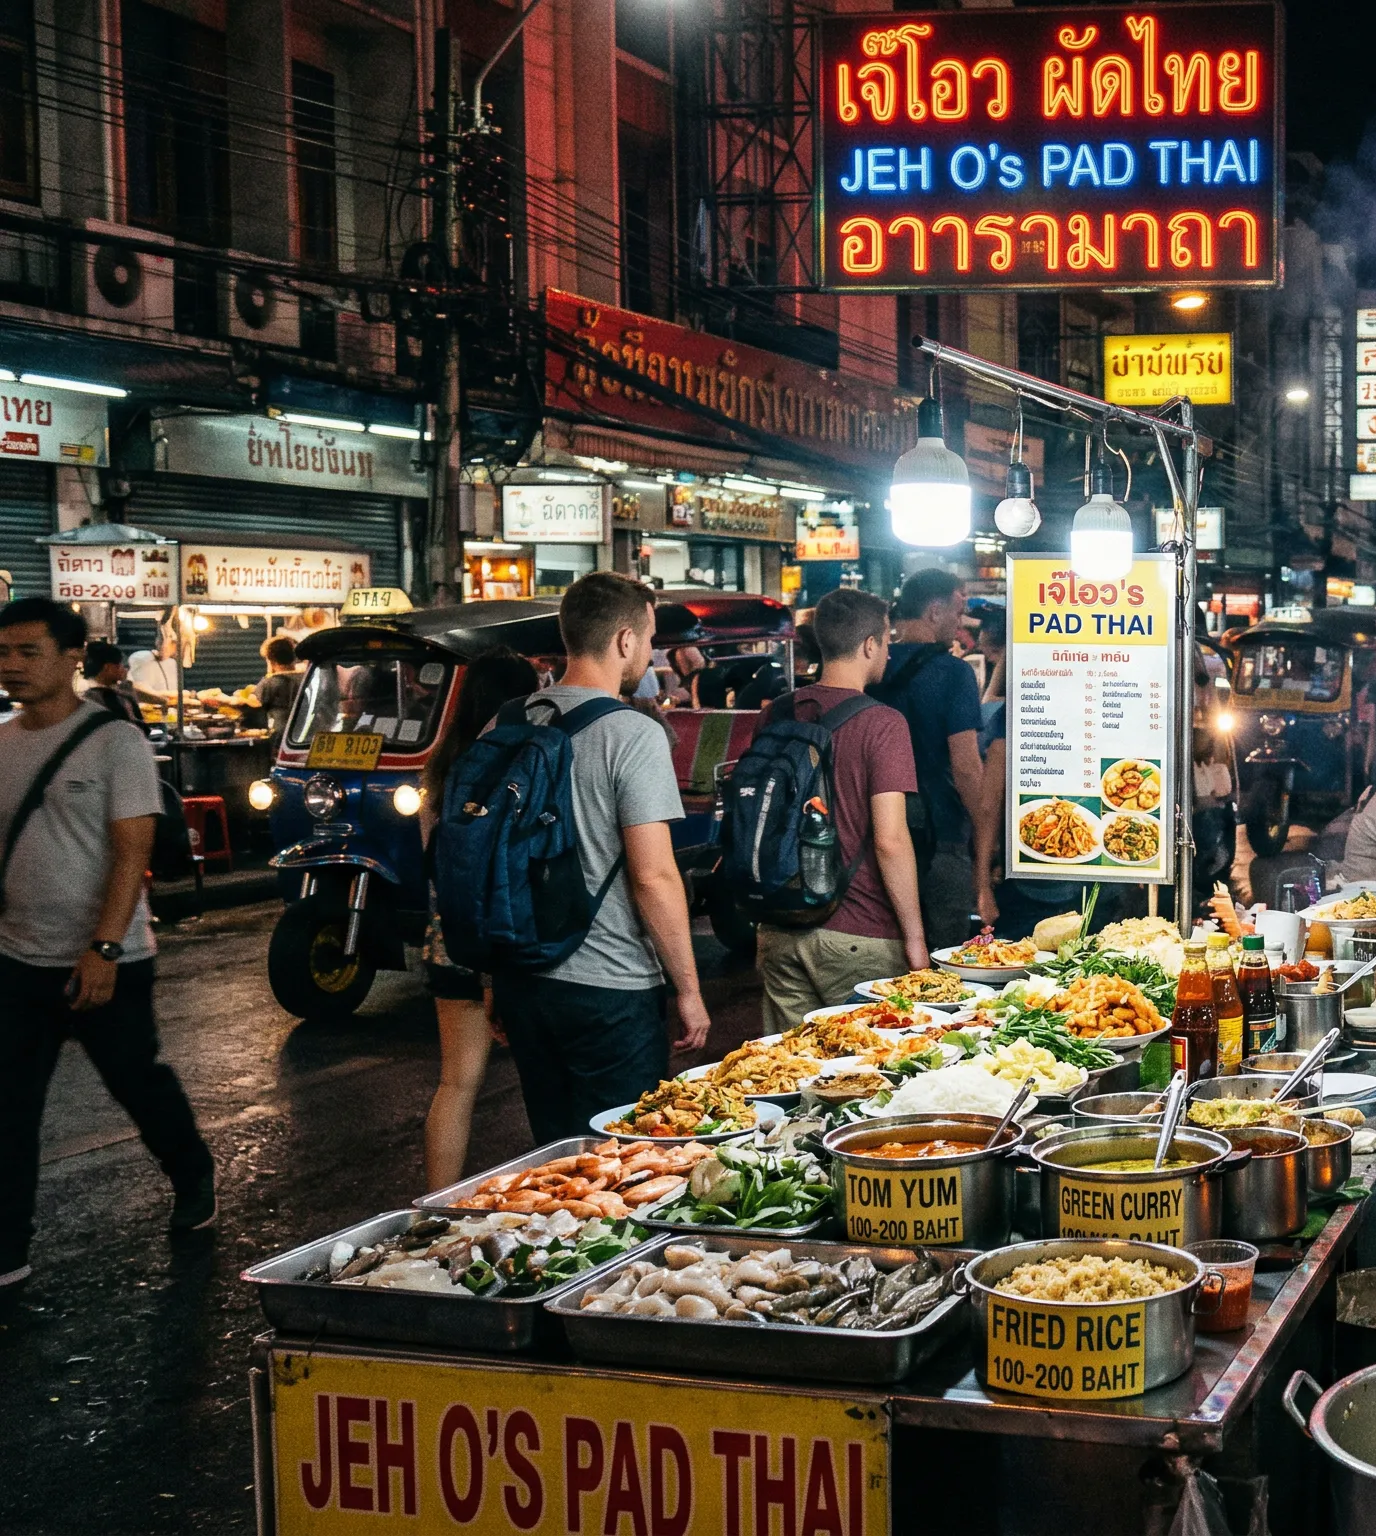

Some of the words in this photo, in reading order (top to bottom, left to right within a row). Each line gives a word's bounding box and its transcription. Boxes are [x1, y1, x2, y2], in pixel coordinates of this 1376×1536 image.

[837, 24, 1009, 123] เจ๊โอว
[1044, 16, 1260, 118] ผัดไทย
[840, 146, 932, 192] JEH
[950, 143, 1026, 189] O's
[1042, 142, 1134, 187] PAD
[1148, 138, 1259, 184] THAI
[1028, 612, 1083, 635] PAD
[1091, 614, 1153, 636] THAI
[848, 1174, 892, 1209] TOM
[900, 1176, 958, 1209] YUM
[1061, 1185, 1115, 1221] GREEN
[1120, 1188, 1184, 1221] CURRY
[849, 1216, 908, 1242] 100-200
[914, 1216, 960, 1241] BAHT
[991, 1303, 1066, 1351] FRIED
[1076, 1311, 1142, 1352] RICE
[993, 1355, 1074, 1391] 100-200
[1081, 1361, 1141, 1393] BAHT
[301, 1393, 417, 1518] JEH
[438, 1403, 545, 1532] O'S
[565, 1414, 694, 1536] PAD
[712, 1428, 863, 1536] THAI
